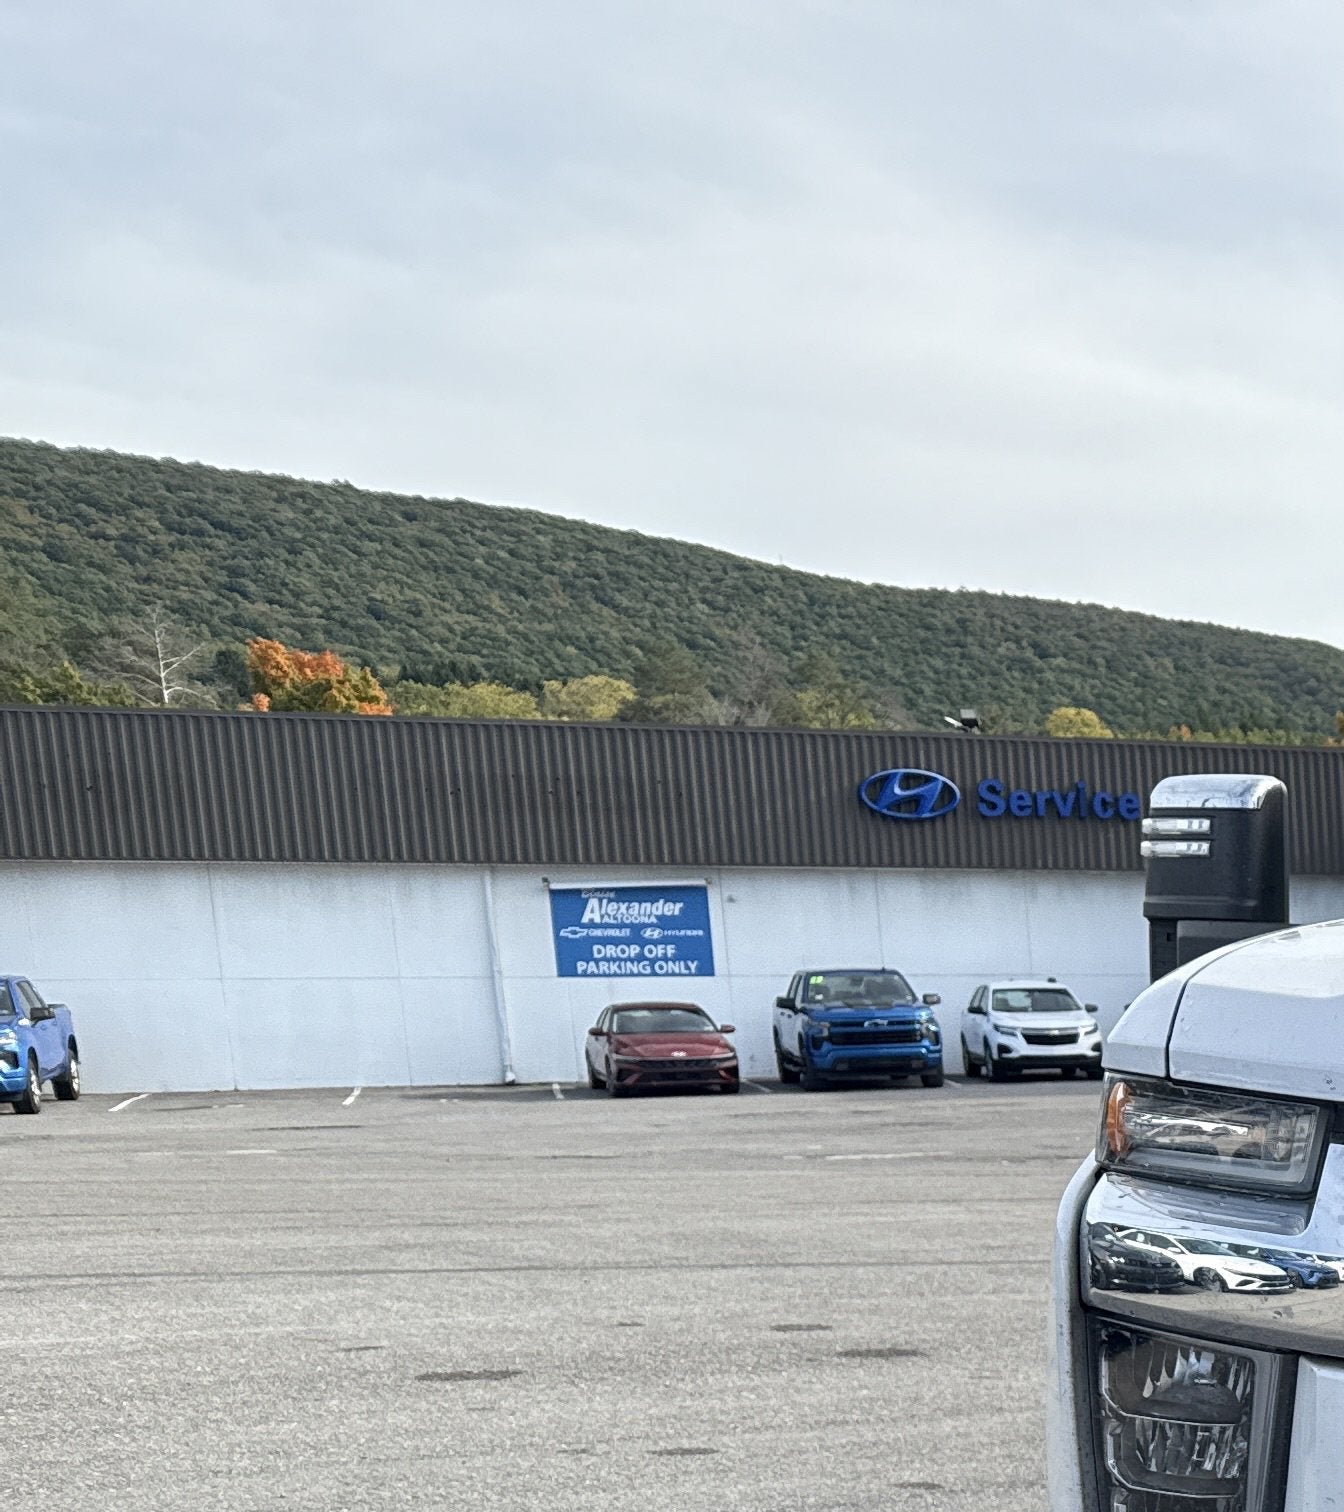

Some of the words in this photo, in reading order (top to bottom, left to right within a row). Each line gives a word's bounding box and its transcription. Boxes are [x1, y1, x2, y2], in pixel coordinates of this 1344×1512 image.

[976, 778, 1141, 820] Service
[581, 898, 684, 923] Alexander
[602, 914, 659, 924] ALTOONA
[592, 944, 641, 959] DROP
[643, 944, 677, 958] OFF
[576, 960, 651, 975] PARKING
[653, 960, 699, 975] ONLY
